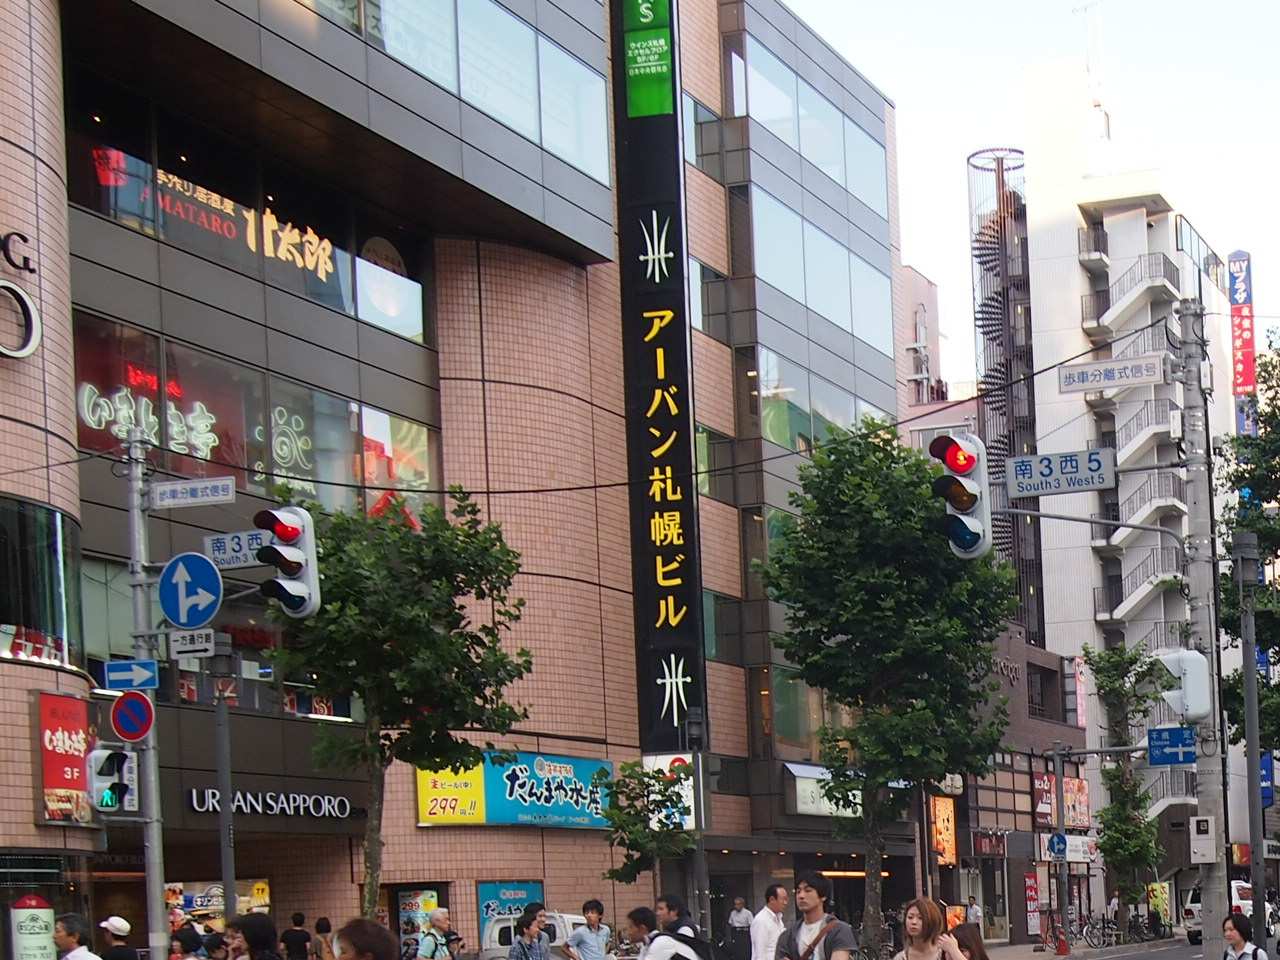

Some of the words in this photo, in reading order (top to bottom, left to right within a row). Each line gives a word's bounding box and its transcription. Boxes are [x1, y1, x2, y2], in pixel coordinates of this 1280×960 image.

[1064, 363, 1157, 386] 歩車分離式信号
[640, 308, 688, 630] アーバン札幌ビル
[1066, 475, 1096, 488] West
[63, 766, 80, 779] 3F
[190, 788, 263, 815] URAN
[265, 791, 350, 819] SAPPORO
